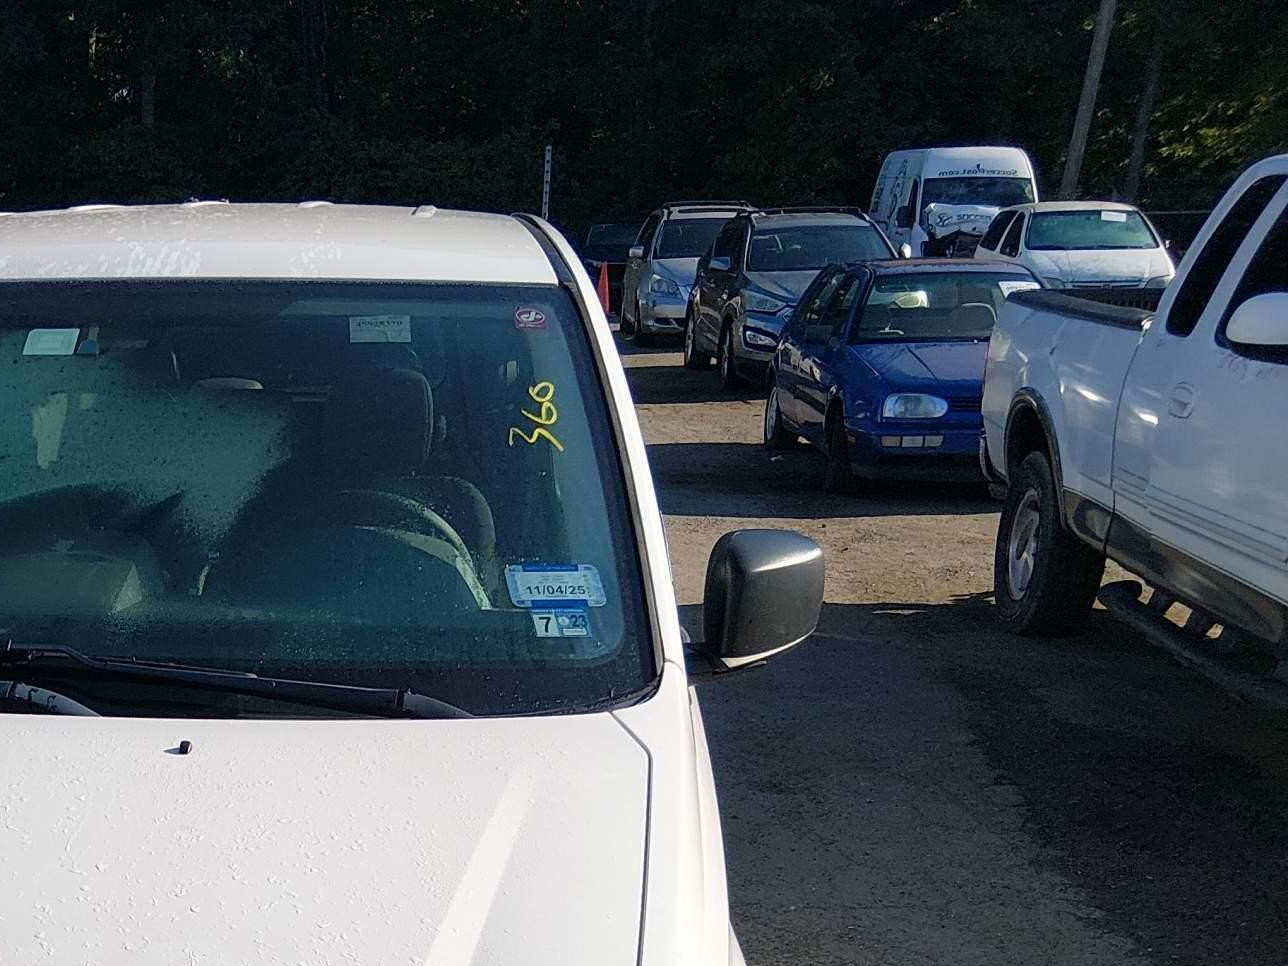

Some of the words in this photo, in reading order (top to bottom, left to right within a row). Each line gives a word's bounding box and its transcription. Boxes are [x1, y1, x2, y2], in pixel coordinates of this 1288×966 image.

[508, 381, 564, 452] 360
[526, 585, 586, 595] 11/04/25
[538, 616, 552, 633] 7
[570, 615, 588, 627] 23
